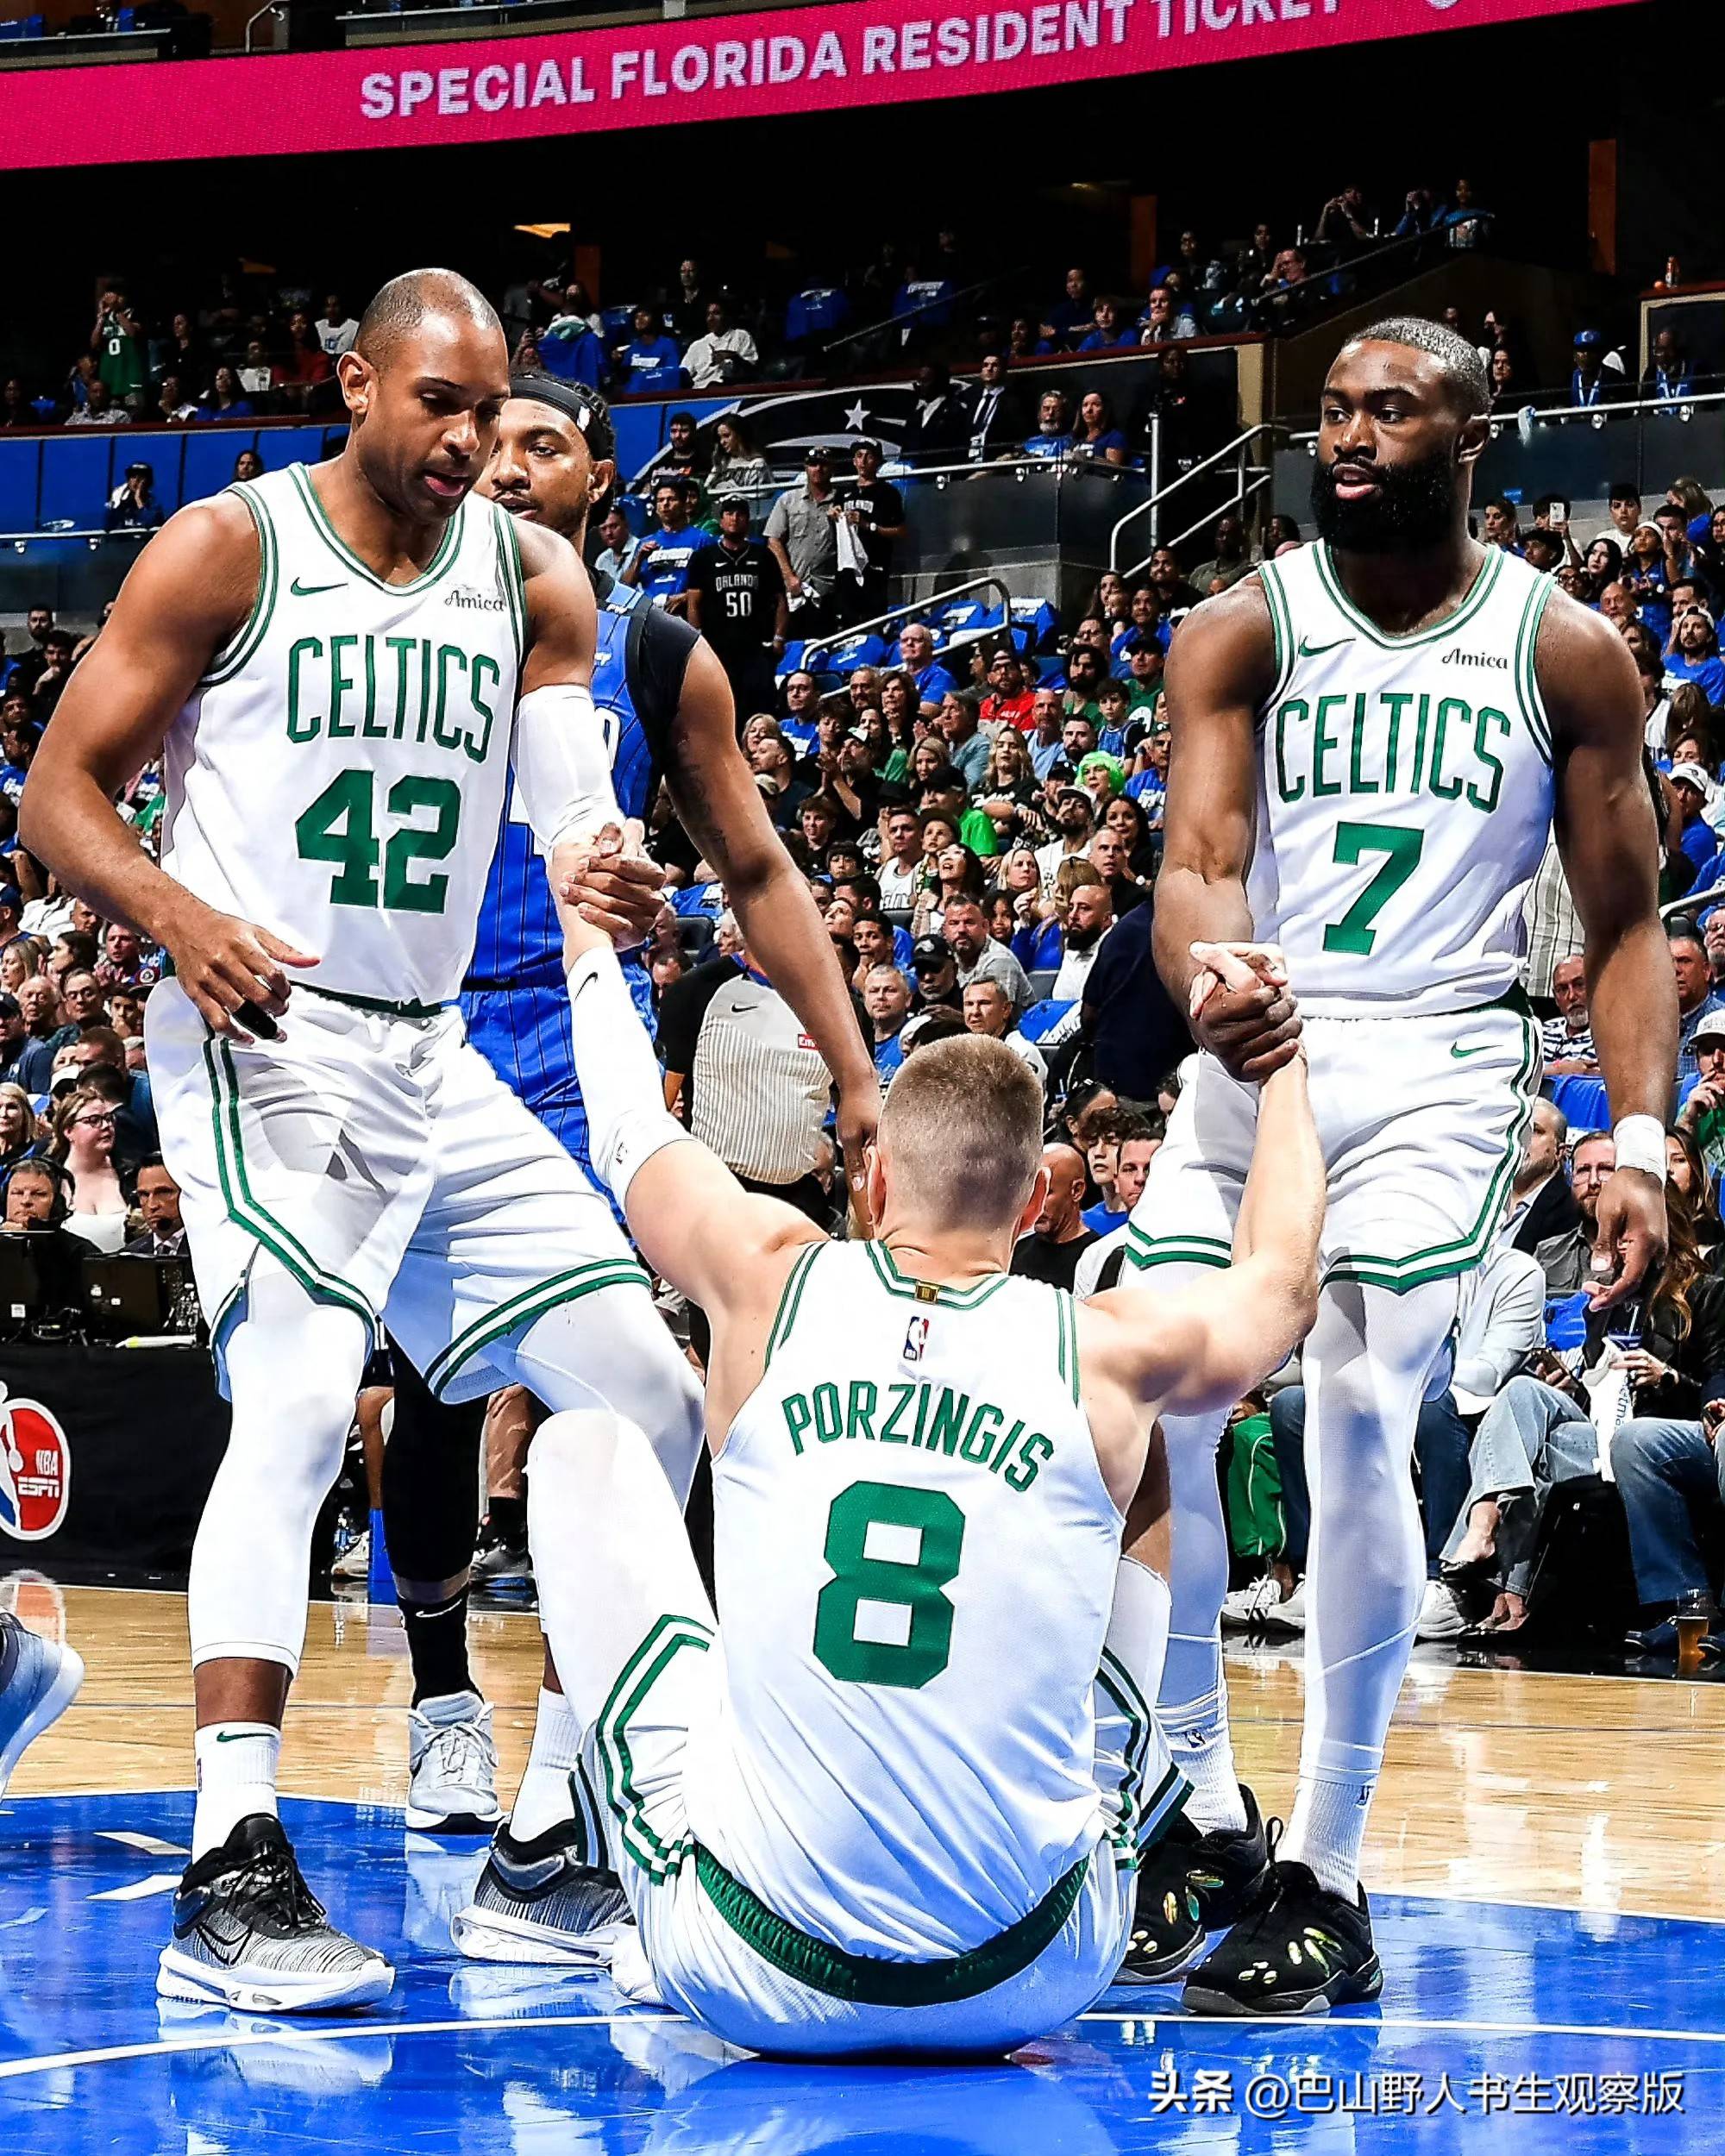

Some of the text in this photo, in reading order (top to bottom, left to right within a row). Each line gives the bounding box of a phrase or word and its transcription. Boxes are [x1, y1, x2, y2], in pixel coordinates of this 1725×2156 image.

[361, 56, 595, 119] SPECIAL
[611, 31, 848, 99] FLORIDA
[862, 0, 1134, 75] RESIDENT
[444, 589, 505, 612] Amica
[726, 592, 752, 617] 50
[286, 635, 500, 764] CELTICS
[1441, 648, 1508, 670] Amica
[1276, 693, 1511, 813] CELTICS
[295, 768, 462, 914] 42
[1322, 821, 1425, 956] 7
[17, 1476, 60, 1498] ESPN
[35, 1449, 59, 1476] NBA
[781, 1381, 1054, 1492] PORZINGIS
[812, 1480, 966, 1690] 8
